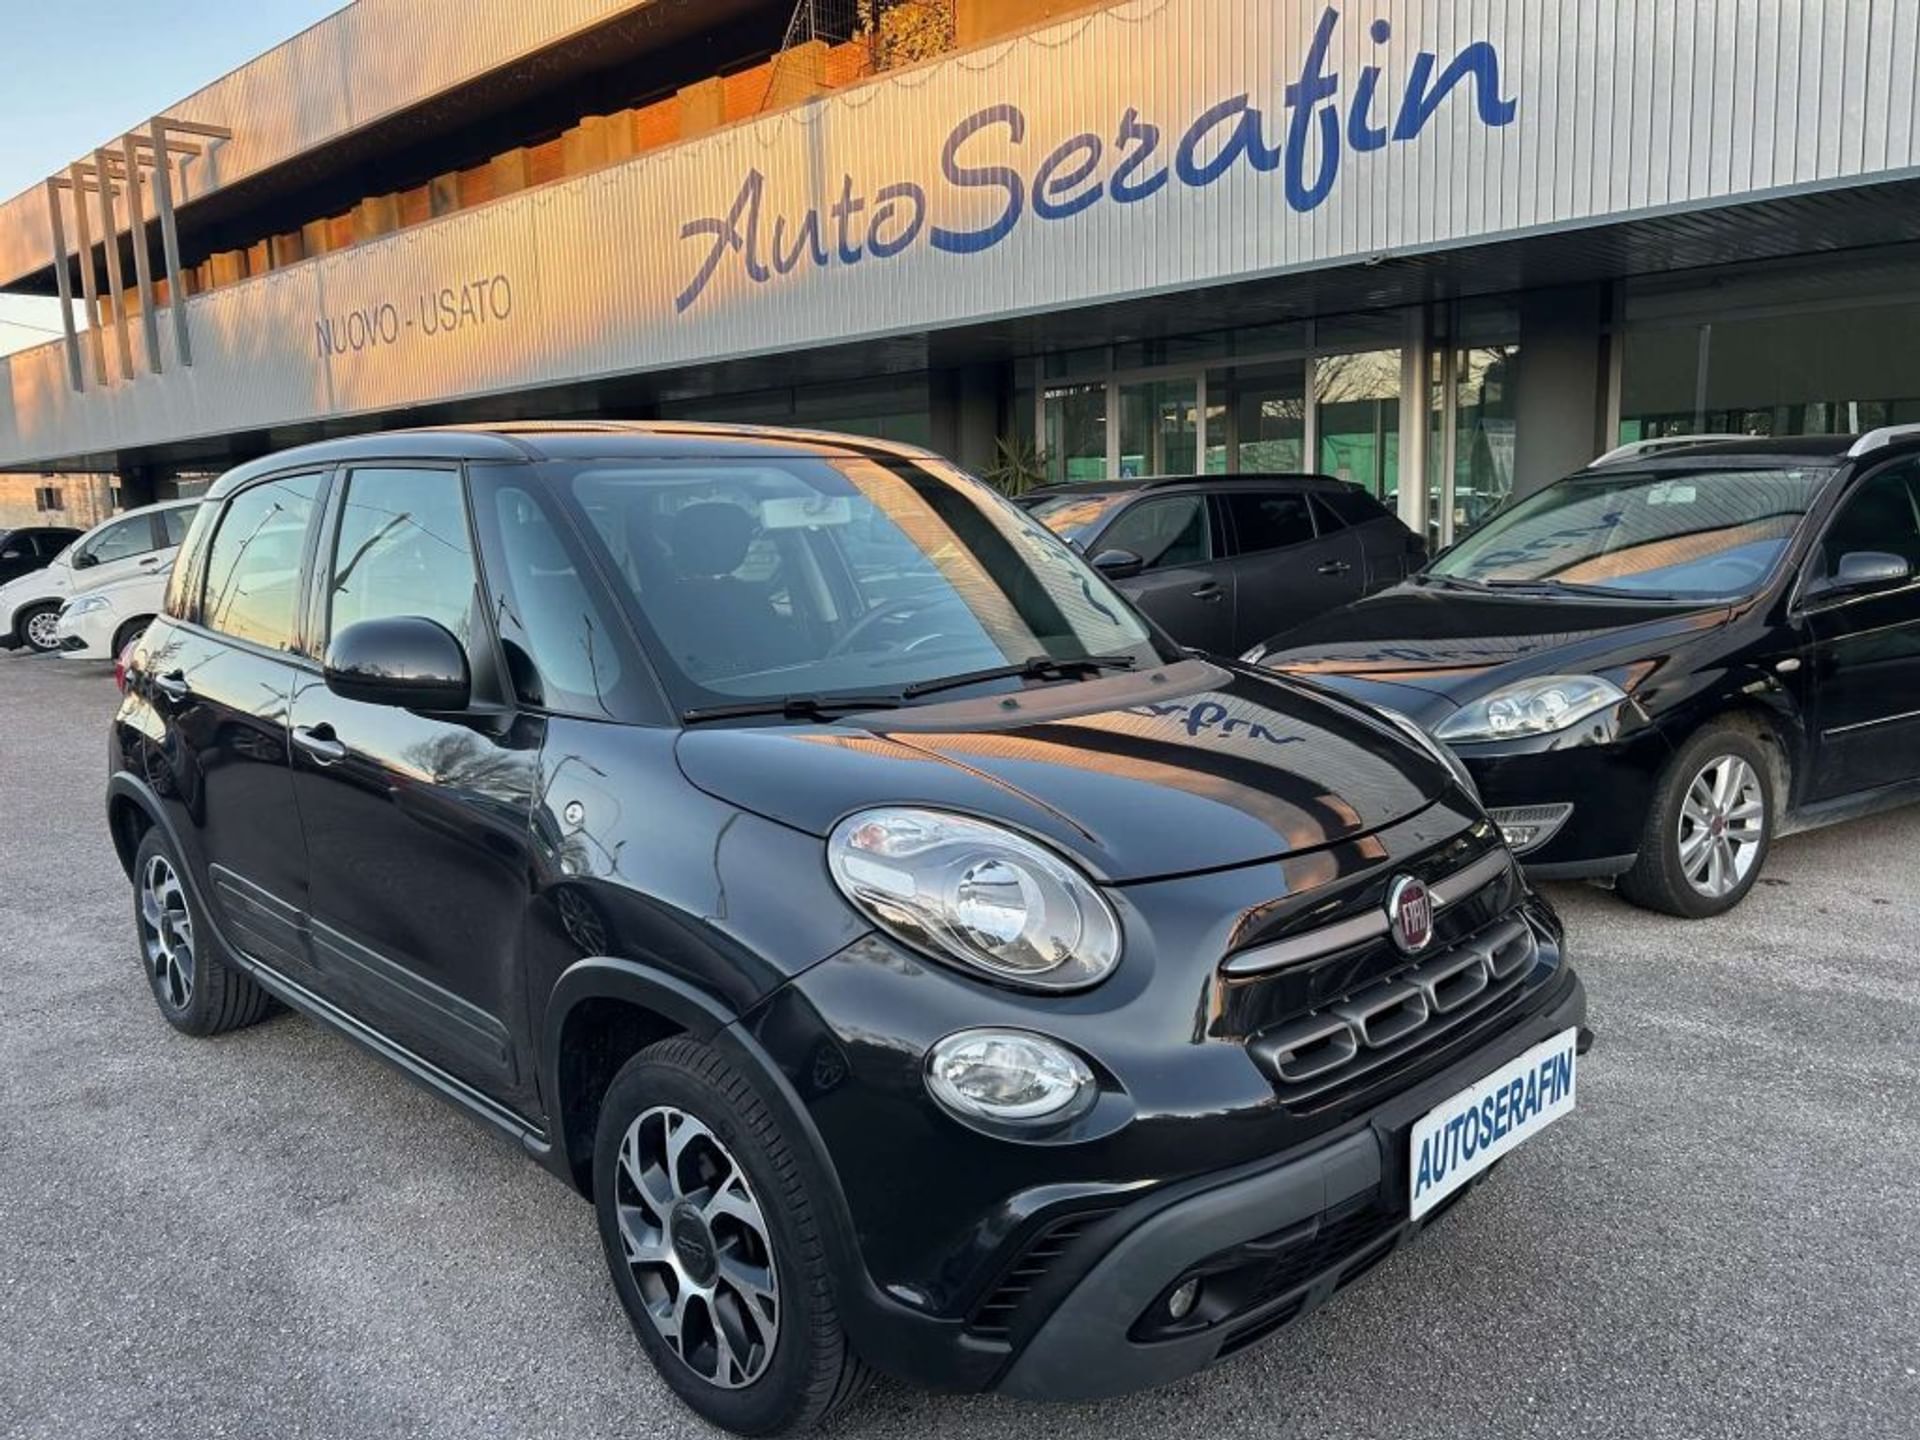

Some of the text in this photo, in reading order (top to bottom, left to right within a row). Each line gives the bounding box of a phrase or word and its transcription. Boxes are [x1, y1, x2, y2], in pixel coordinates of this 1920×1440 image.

[315, 304, 398, 357] NUOVO
[420, 275, 511, 335] USATO
[1414, 1047, 1573, 1199] AUTOSERAFIN
